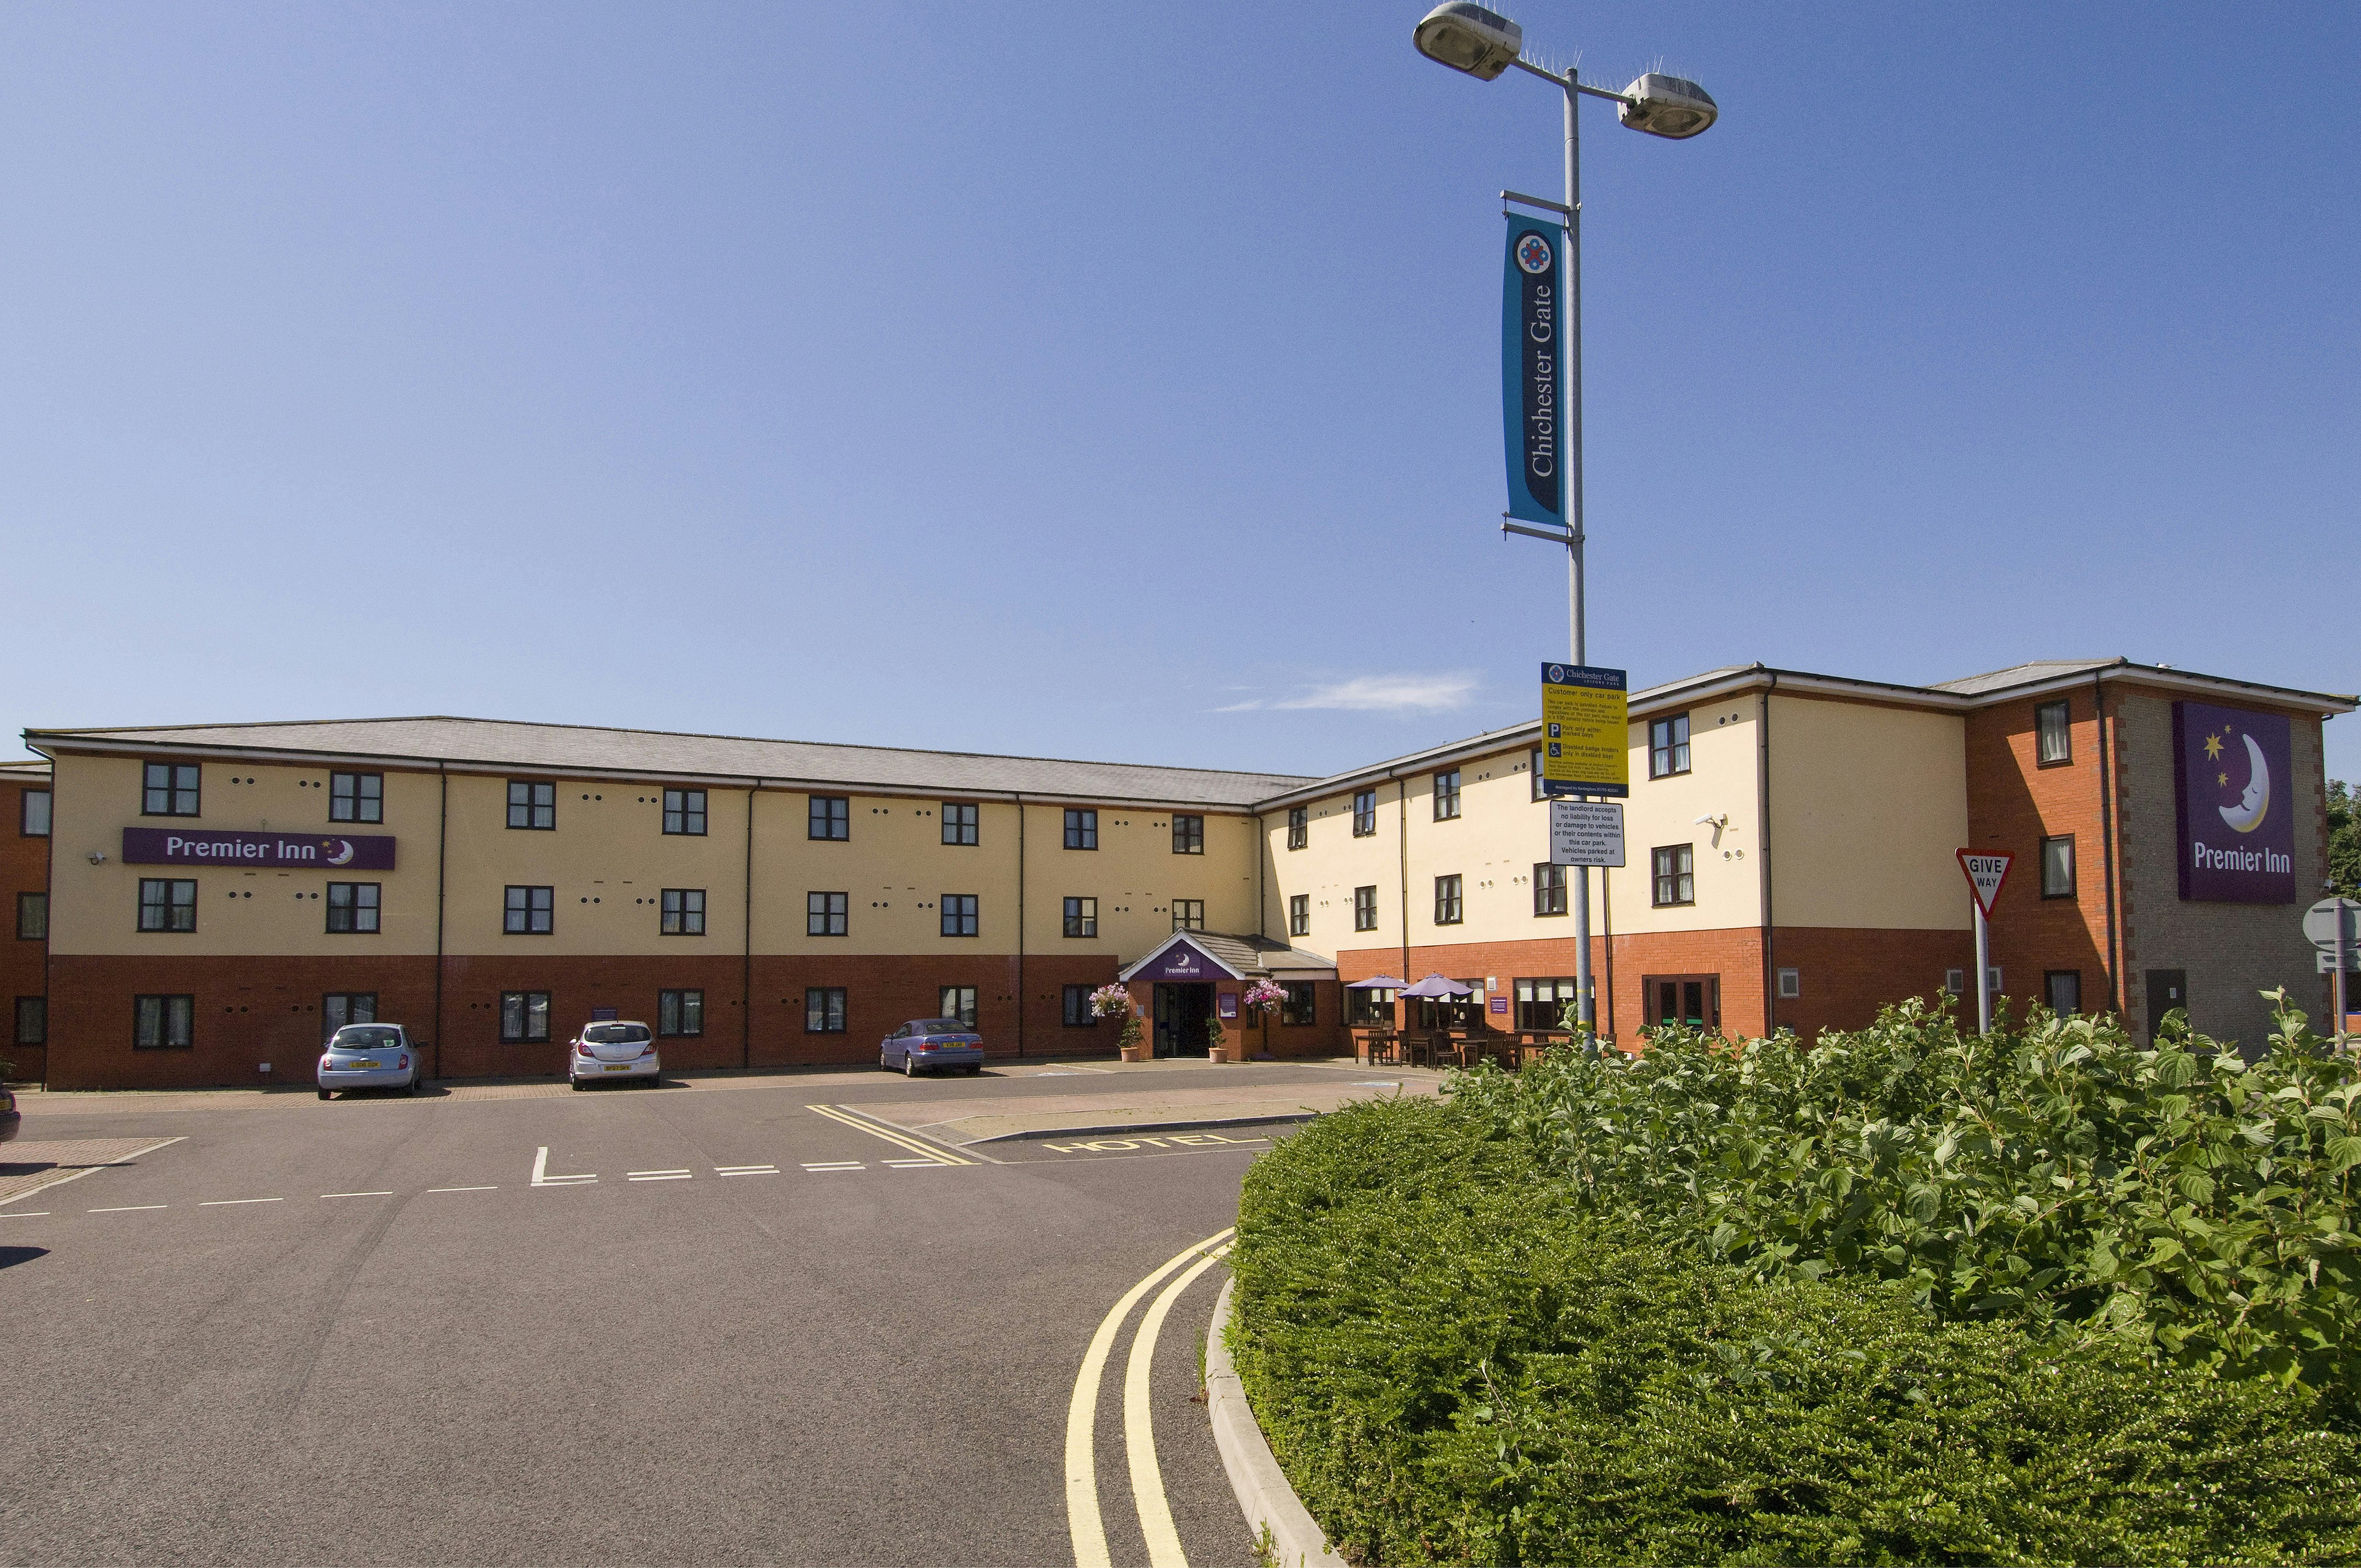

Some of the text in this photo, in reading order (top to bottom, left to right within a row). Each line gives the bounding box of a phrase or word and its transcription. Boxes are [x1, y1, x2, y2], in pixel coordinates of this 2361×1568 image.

[1530, 285, 1553, 477] Chichester Gate
[1566, 669, 1619, 682] Chichester Gate
[1548, 687, 1577, 696] Customer
[1551, 724, 1559, 737] P
[166, 837, 315, 860] Premier Inn
[2194, 842, 2289, 873] Premier Inn
[1970, 859, 2002, 873] GIVE
[1977, 878, 1997, 887] WAY
[1042, 1135, 1269, 1153] HOTEL
